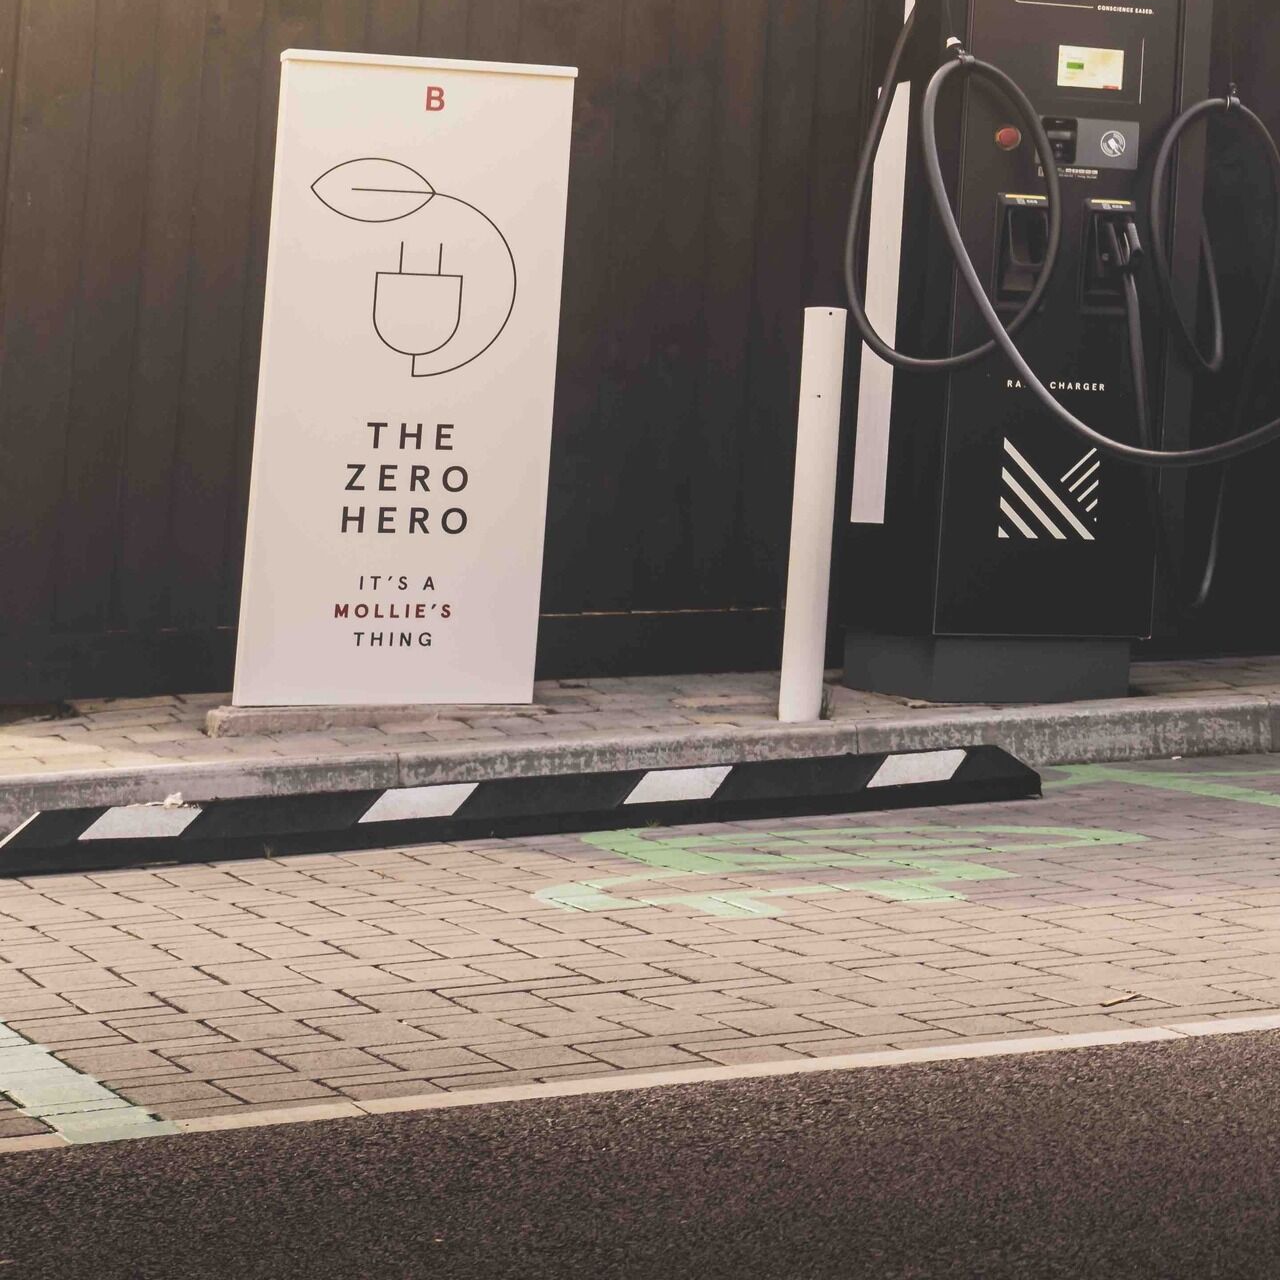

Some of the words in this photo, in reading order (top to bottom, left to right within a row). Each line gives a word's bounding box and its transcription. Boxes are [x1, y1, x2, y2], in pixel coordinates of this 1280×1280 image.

[1097, 4, 1134, 13] CONSCIENCE
[426, 86, 445, 111] B
[1049, 381, 1105, 391] CHARGER
[367, 422, 454, 451] THE
[344, 463, 469, 493] ZERO
[341, 506, 468, 535] HERO
[359, 575, 408, 591] IT'S
[422, 576, 435, 591] A
[334, 603, 451, 619] MOLLIE'S
[353, 631, 432, 647] THING
